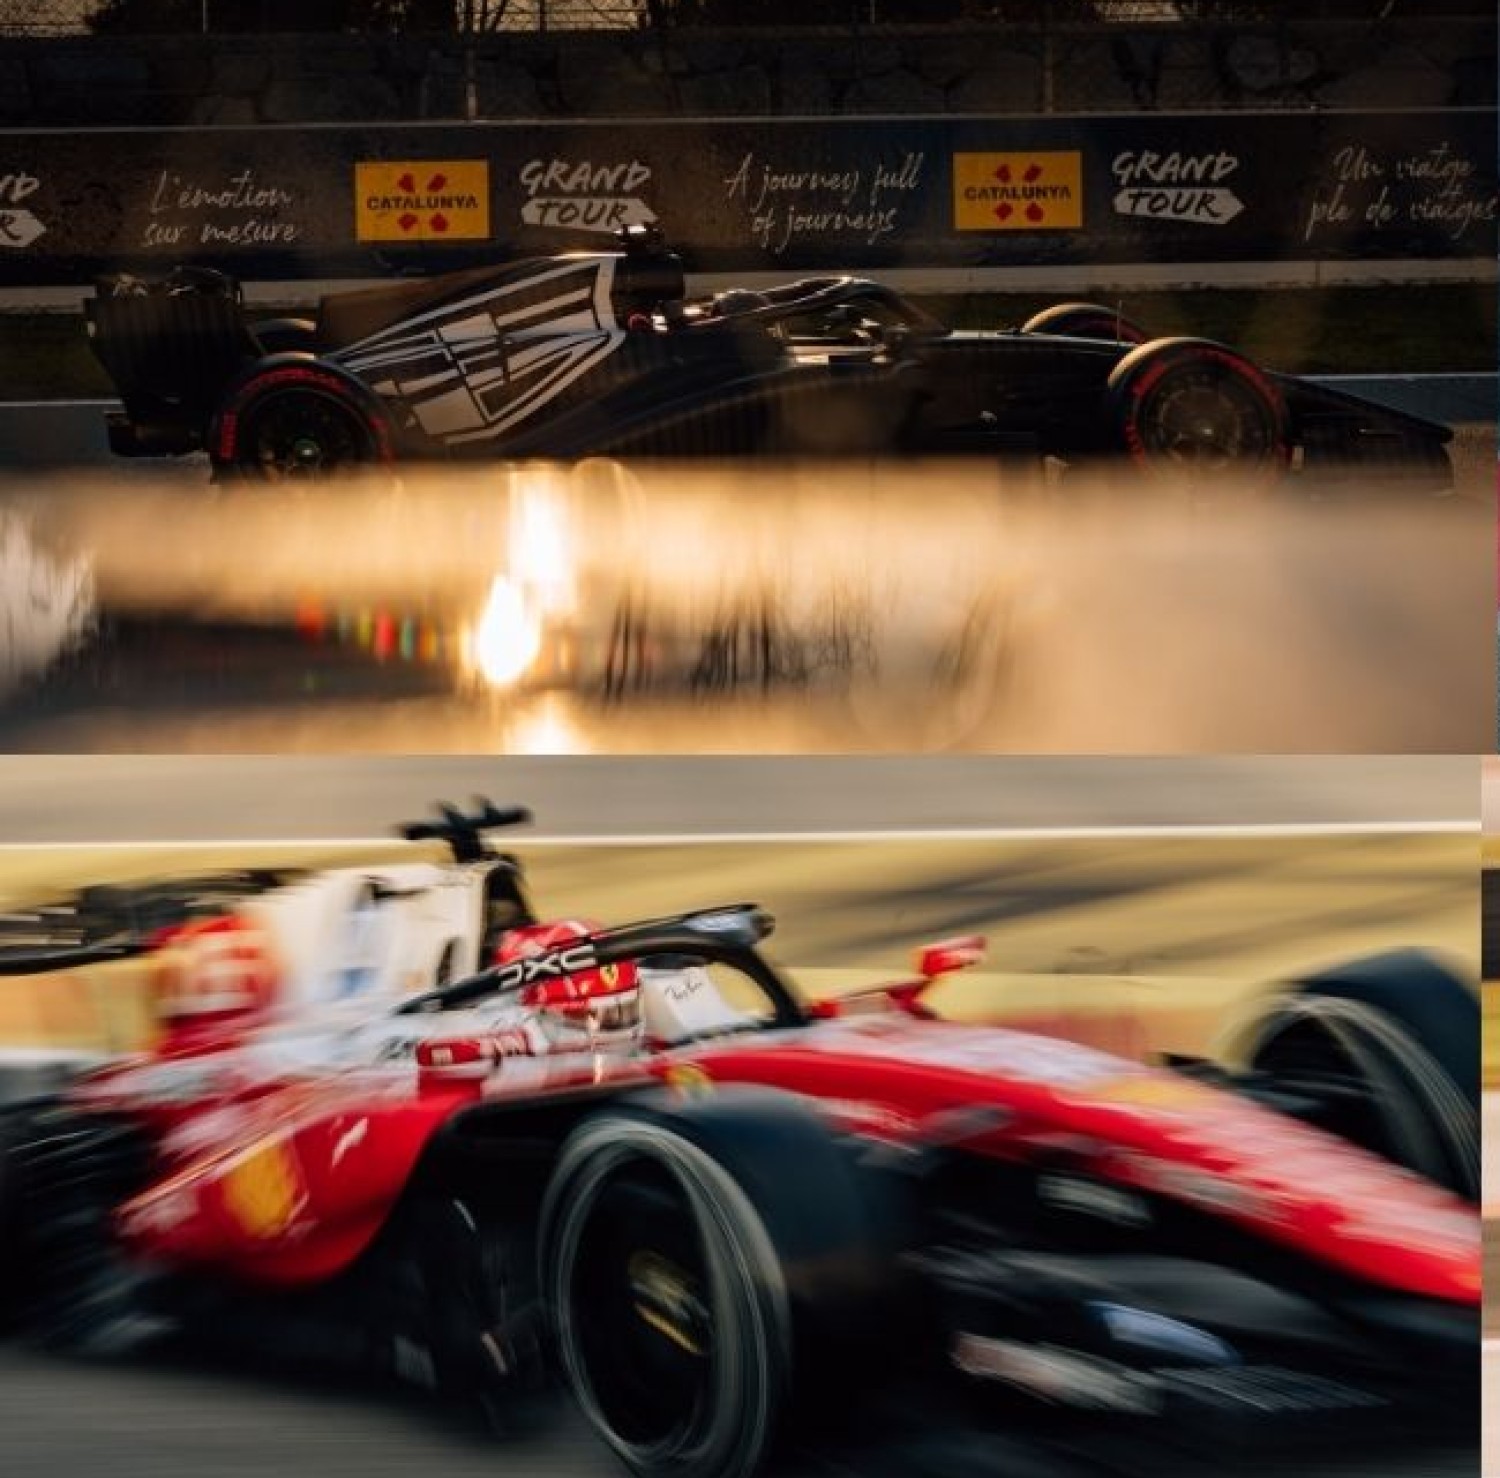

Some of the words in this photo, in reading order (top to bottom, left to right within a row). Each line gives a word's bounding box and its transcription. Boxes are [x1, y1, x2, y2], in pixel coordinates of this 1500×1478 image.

[520, 159, 651, 196] GRAND
[724, 152, 752, 199] A
[750, 164, 860, 213] journey
[868, 152, 924, 206] full
[1111, 150, 1239, 187] GRAND
[1334, 146, 1386, 182] Un
[1396, 141, 1476, 198] viatge
[366, 195, 479, 212] CATALUNYA
[964, 184, 1073, 202] CATALUNYA
[1127, 190, 1222, 220] TOUR
[535, 200, 629, 227] TOUR
[752, 207, 777, 249] of
[774, 204, 898, 255] journeys
[1305, 184, 1351, 241] ple
[1364, 186, 1399, 227] de
[142, 223, 188, 248] sur
[201, 219, 298, 244] mesure
